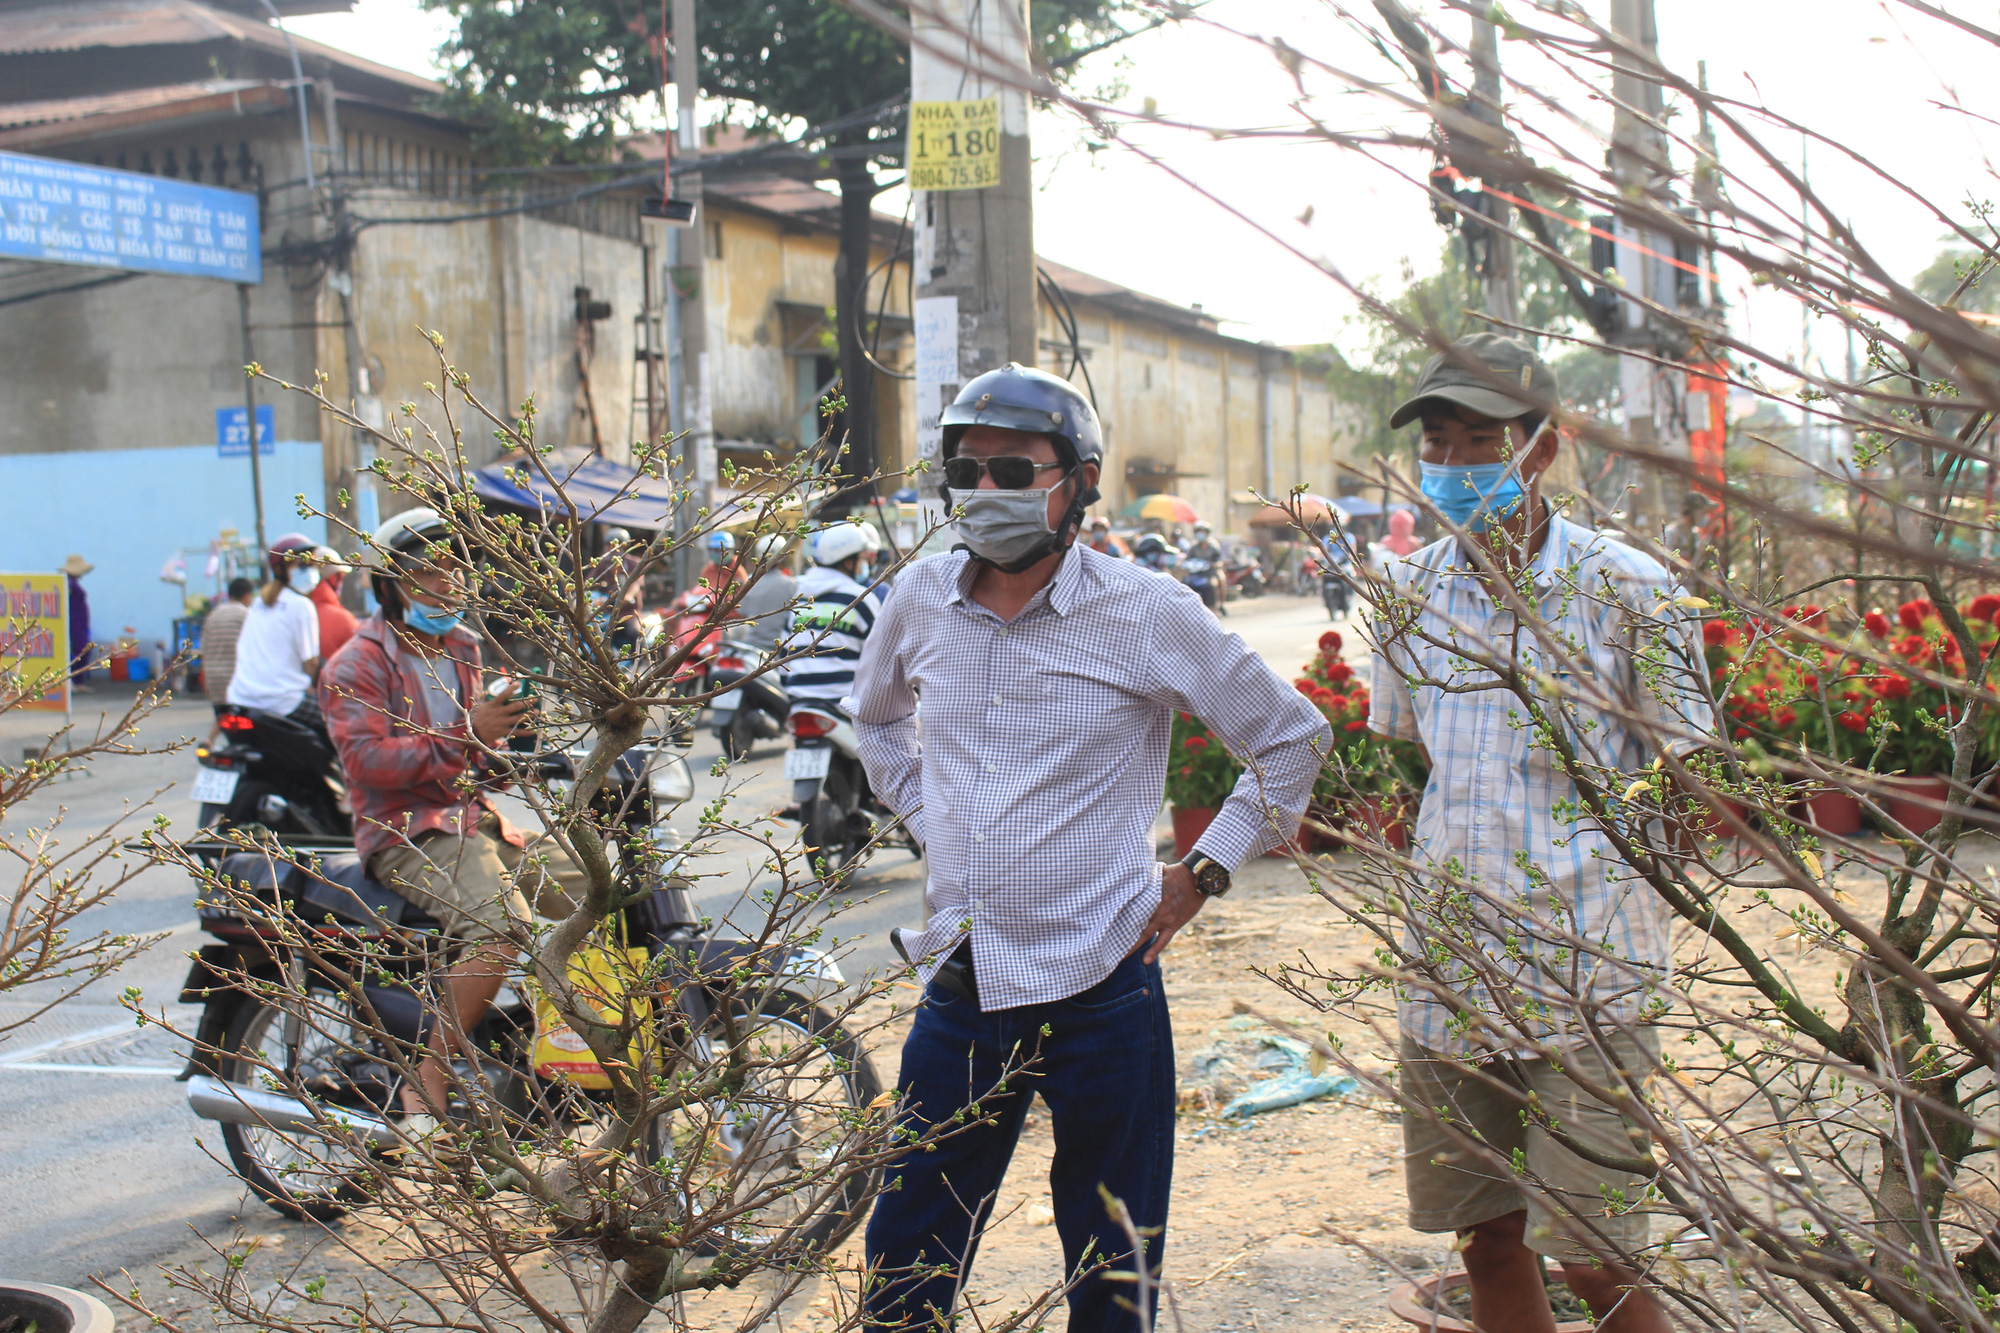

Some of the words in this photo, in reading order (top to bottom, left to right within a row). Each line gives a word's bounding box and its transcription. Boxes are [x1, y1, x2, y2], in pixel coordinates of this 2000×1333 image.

[946, 127, 996, 157] 180
[0, 176, 34, 199] HÂN
[78, 189, 111, 211] KHU
[116, 193, 147, 216] PHỐ
[80, 209, 113, 231] CÁC
[166, 244, 196, 264] KHU
[225, 423, 266, 443] 277
